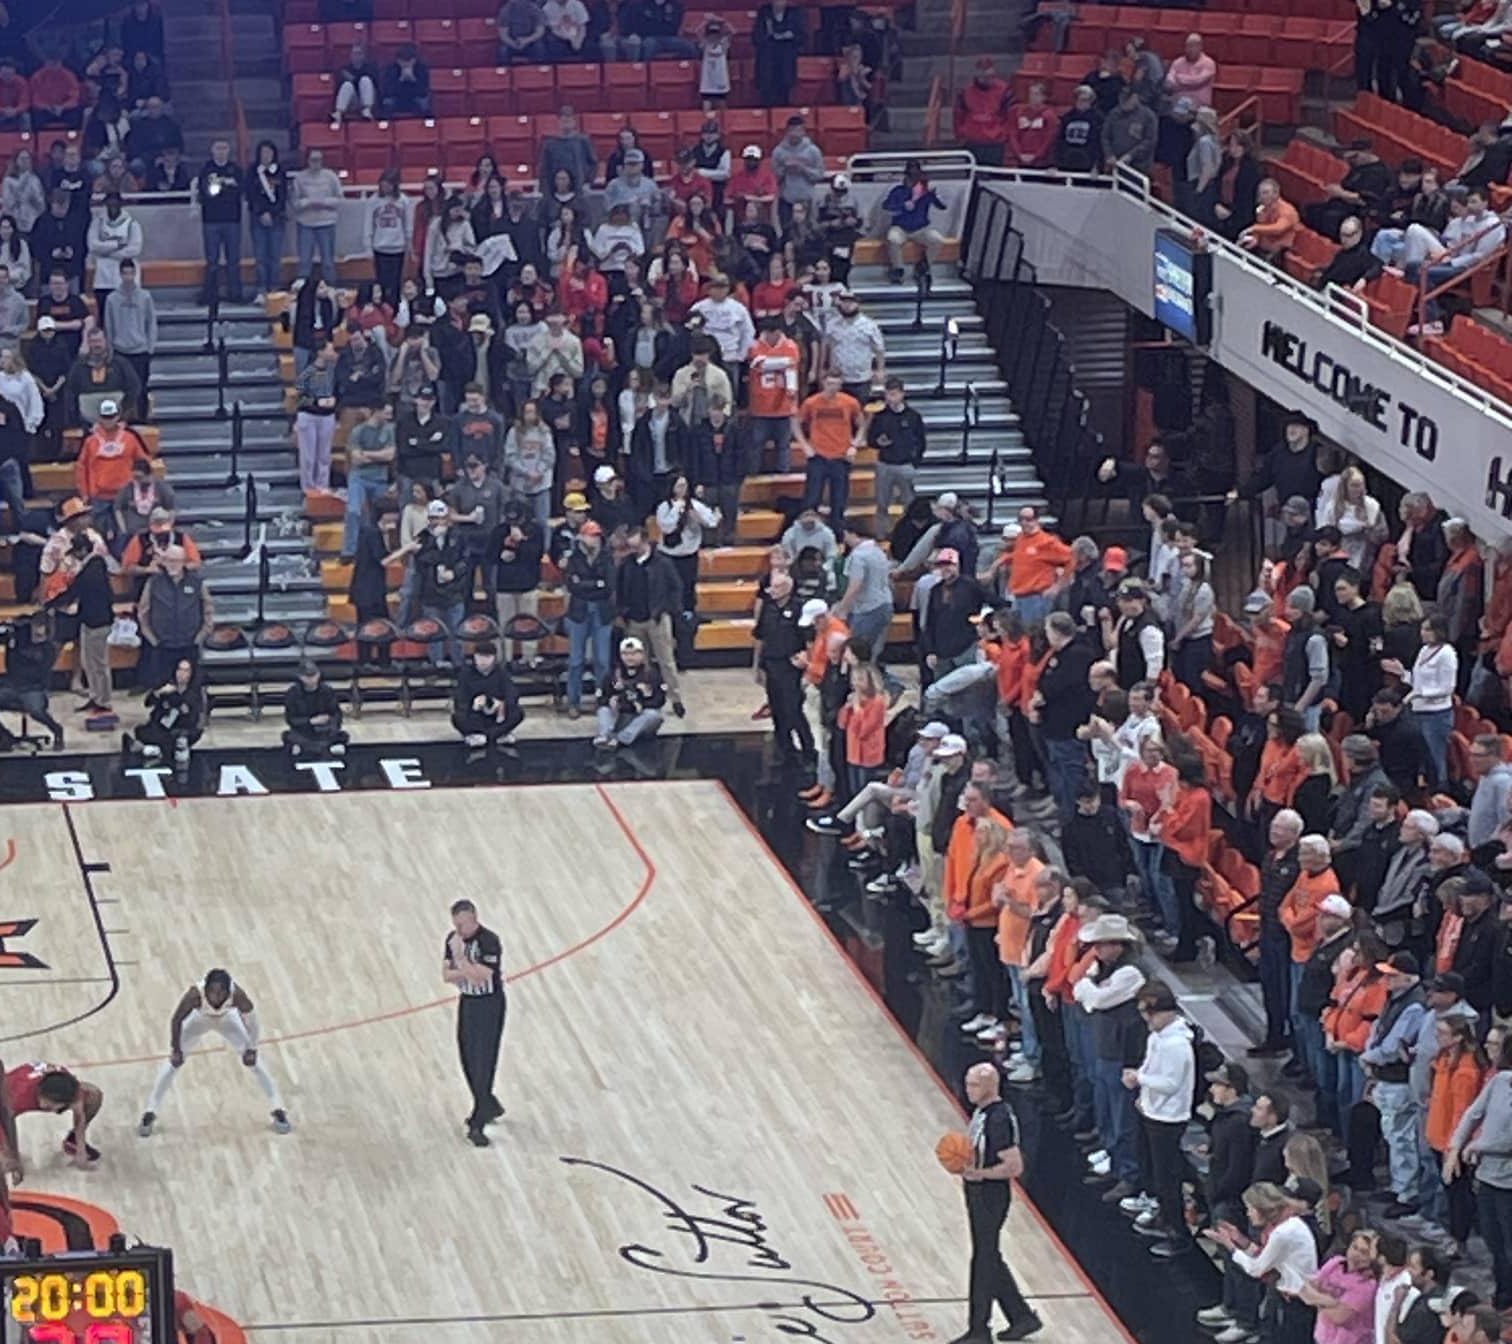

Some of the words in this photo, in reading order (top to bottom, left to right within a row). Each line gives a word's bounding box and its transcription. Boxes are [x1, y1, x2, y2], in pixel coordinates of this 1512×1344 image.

[1261, 320, 1391, 433] WELCOME
[1398, 402, 1438, 463] TO
[44, 757, 431, 802] STATE
[843, 1227, 893, 1275] COURT
[11, 1270, 145, 1321] 20:00
[880, 1280, 936, 1340] SUTTON
